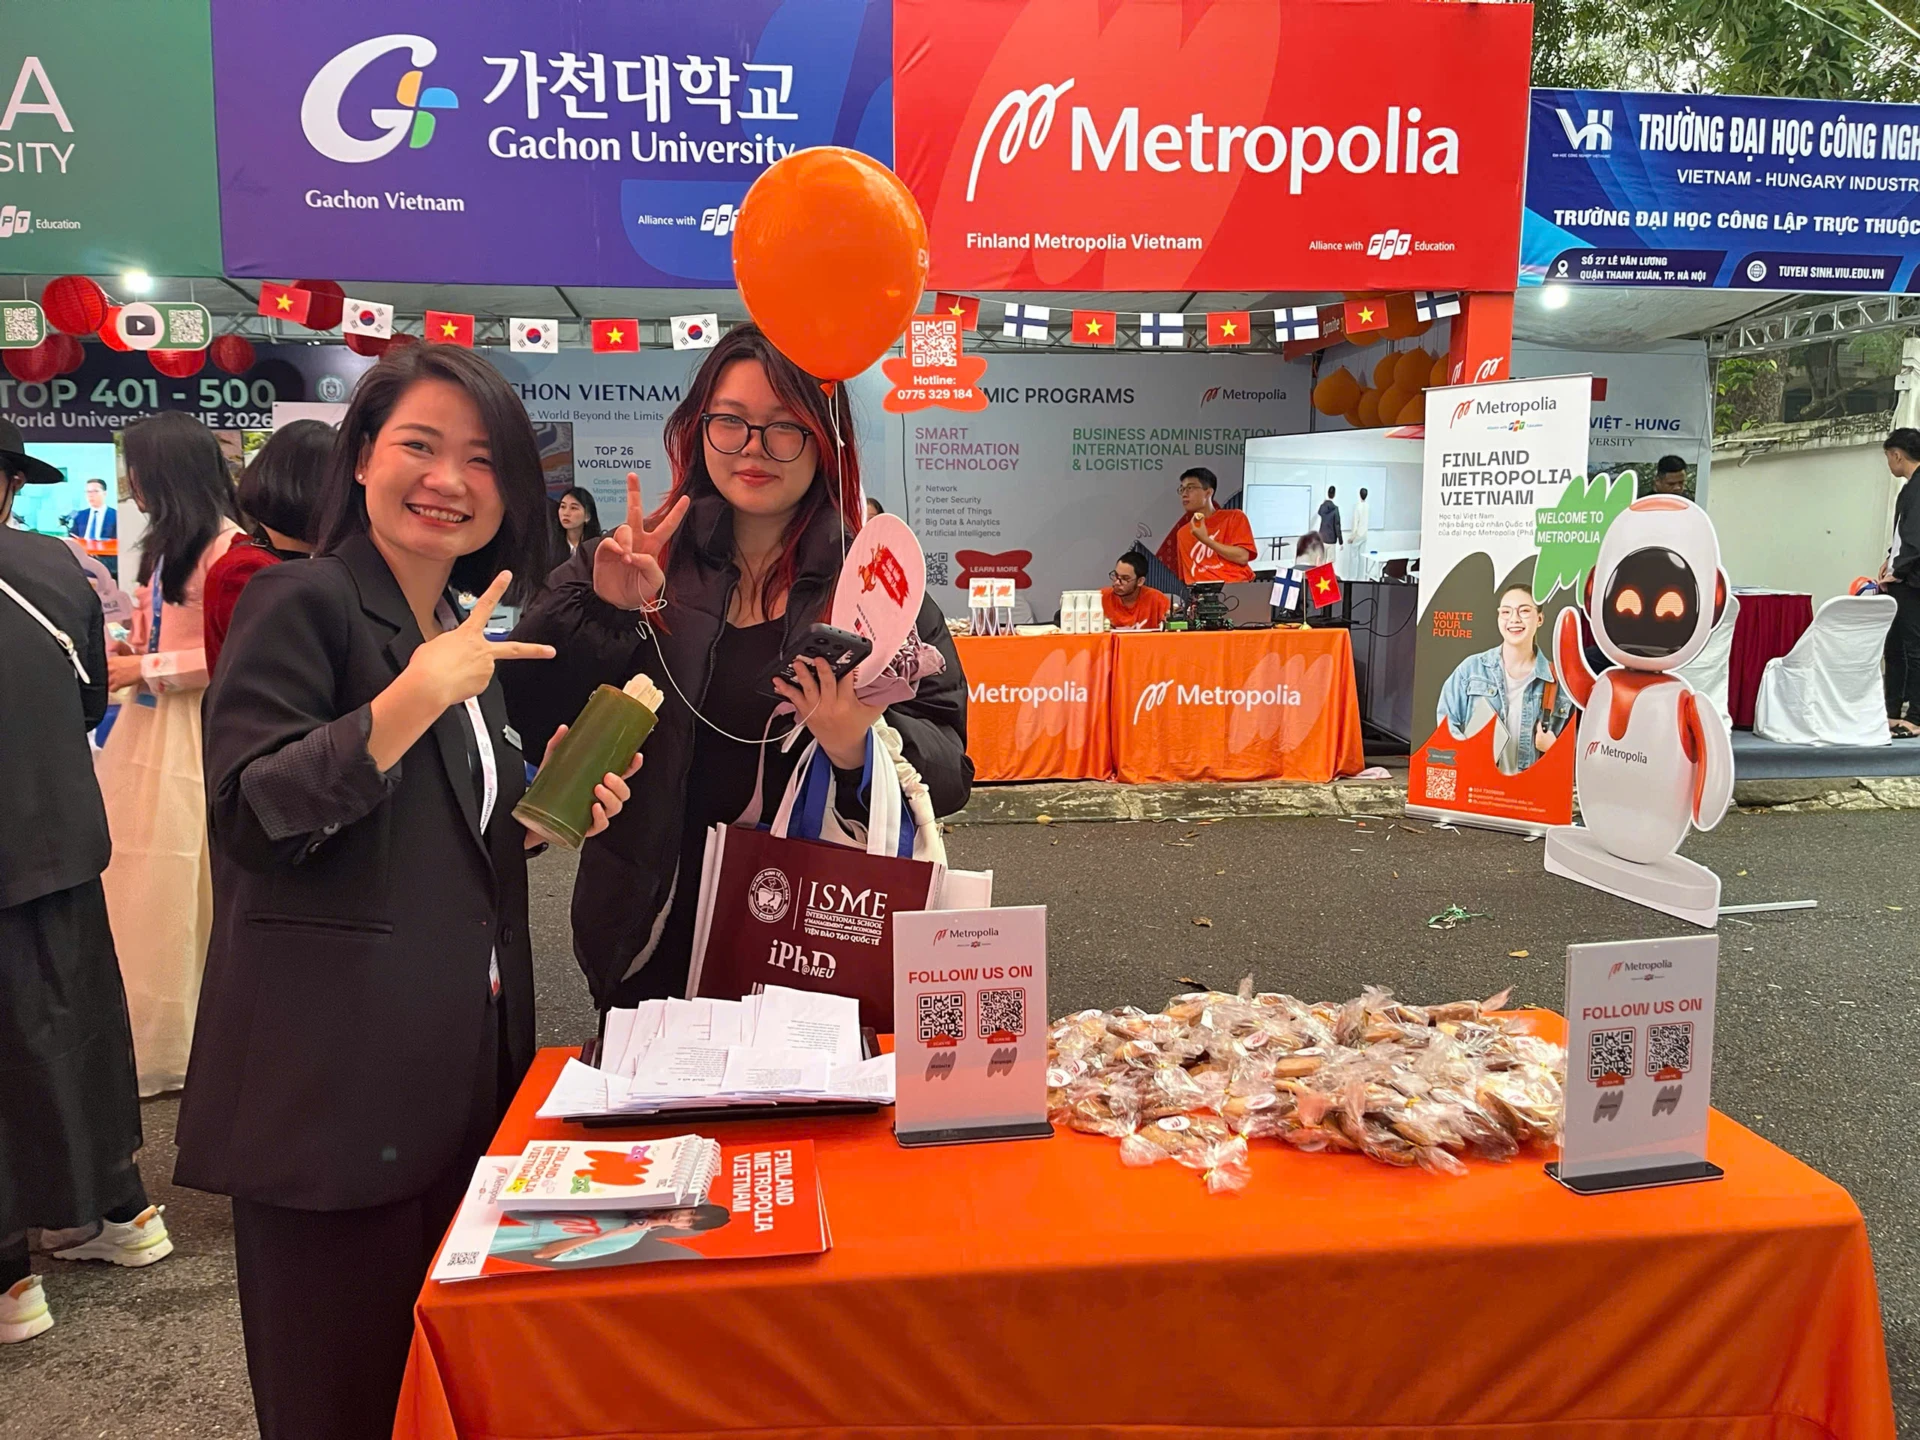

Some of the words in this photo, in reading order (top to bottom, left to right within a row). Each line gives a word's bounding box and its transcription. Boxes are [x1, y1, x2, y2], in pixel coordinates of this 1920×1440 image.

[0, 57, 74, 132] A
[482, 50, 799, 125] 가천대학교
[1639, 106, 1724, 152] TRƯỜNG
[1730, 117, 1766, 162] ĐẠI
[1771, 119, 1814, 164] HỌC
[1820, 114, 1877, 160] CÔNG
[1881, 123, 1920, 161] NGH
[488, 126, 621, 161] Gachon
[631, 131, 796, 165] University
[1071, 106, 1460, 195] Metropolia
[0, 142, 75, 173] SITY
[1677, 169, 1751, 186] VIETNAM
[1765, 173, 1846, 189] HUNGARY
[305, 190, 379, 211] Gachon
[385, 191, 465, 212] Vietnam
[36, 219, 81, 229] Education
[638, 215, 674, 225] Alliance
[676, 216, 696, 226] with
[1554, 207, 1631, 227] TRƯỜNG
[1635, 210, 1668, 231] ĐẠI
[1673, 211, 1711, 231] HỌC
[1717, 210, 1768, 230] CÔNG
[1774, 211, 1808, 233] LẬP
[1813, 216, 1859, 236] TRỰC
[1865, 216, 1920, 237] THUỘC
[967, 232, 1030, 251] Finland
[1034, 232, 1126, 253] Metropolia
[1131, 233, 1203, 251] Vietnam
[1309, 241, 1343, 250] Alliance
[1345, 241, 1363, 250] with
[1366, 229, 1412, 260] FPT
[1415, 241, 1455, 251] Education
[1581, 254, 1594, 265] SỐ
[1595, 256, 1606, 266] 27
[1608, 255, 1618, 266] LÊ
[1580, 268, 1604, 281] QUẬN
[1606, 270, 1634, 280] THANH
[1664, 271, 1676, 281] TP.
[1677, 269, 1689, 281] HÀ
[1690, 270, 1706, 283] NỘI
[1779, 266, 1808, 278] TUYEN
[1810, 267, 1885, 280] SINH.VIU.EDU.VN
[913, 375, 957, 386] Hotline:
[0, 379, 77, 408] TOP
[90, 379, 158, 408] 401
[199, 379, 276, 408] 500
[578, 384, 681, 401] VIETNAM
[897, 390, 926, 399] 0775
[928, 389, 950, 399] 329
[953, 389, 973, 399] 184
[1025, 387, 1135, 404] PROGRAMS
[1223, 389, 1287, 402] Metropolia
[1476, 396, 1557, 416] Metropolia
[224, 412, 272, 428] 2026
[538, 410, 570, 420] World
[573, 411, 611, 422] Beyond
[614, 411, 631, 420] the
[634, 411, 664, 420] Limits
[1589, 415, 1623, 432] VIỆT
[1635, 418, 1681, 431] HUNG
[915, 427, 968, 440] SMART
[1073, 428, 1146, 441] BUSINESS
[594, 446, 617, 455] TOP
[620, 446, 634, 455] 26
[915, 443, 1019, 455] INFORMATION
[1072, 443, 1190, 456] INTERNATIONAL
[578, 460, 652, 469] WORLDWIDE
[915, 458, 1019, 470] TECHNOLOGY
[1072, 459, 1081, 470] &
[1086, 459, 1163, 470] LOGISTICS
[1442, 450, 1530, 468] FINLAND
[1441, 468, 1572, 488] METROPOLIA
[926, 496, 948, 504] Cyber
[950, 496, 981, 504] Security
[1441, 490, 1534, 506] VIETNAM
[926, 507, 956, 515] Internet
[967, 507, 992, 516] Things
[1538, 511, 1586, 525] WELCOME
[1587, 511, 1604, 523] TO
[926, 519, 937, 527] Big
[966, 519, 1000, 527] Analytics
[926, 529, 957, 537] Artificial
[958, 530, 1001, 538] Intelligence
[1536, 531, 1601, 544] METROPOLIA
[1433, 611, 1473, 621] IGNITE
[1432, 628, 1473, 638] FUTURE
[1433, 620, 1461, 630] YOUR
[967, 681, 1088, 709] Metropolia
[1178, 684, 1302, 712] Metropolia
[1600, 744, 1648, 764] Metropolia
[807, 881, 888, 919] ISME
[805, 911, 856, 924] INTERNATIONAL
[857, 919, 883, 929] SCHOOL
[950, 928, 999, 939] Metropolia
[1624, 960, 1672, 972] Metropolia
[909, 968, 978, 984] FOLLOW
[982, 966, 1004, 979] US
[1008, 965, 1033, 978] ON
[1583, 1002, 1649, 1020] FOLLOW
[1653, 1000, 1674, 1014] US
[1679, 998, 1702, 1012] ON
[732, 1153, 751, 1212] VIETNAM
[774, 1150, 795, 1206] FINLAND
[754, 1151, 774, 1233] METROPOLIA
